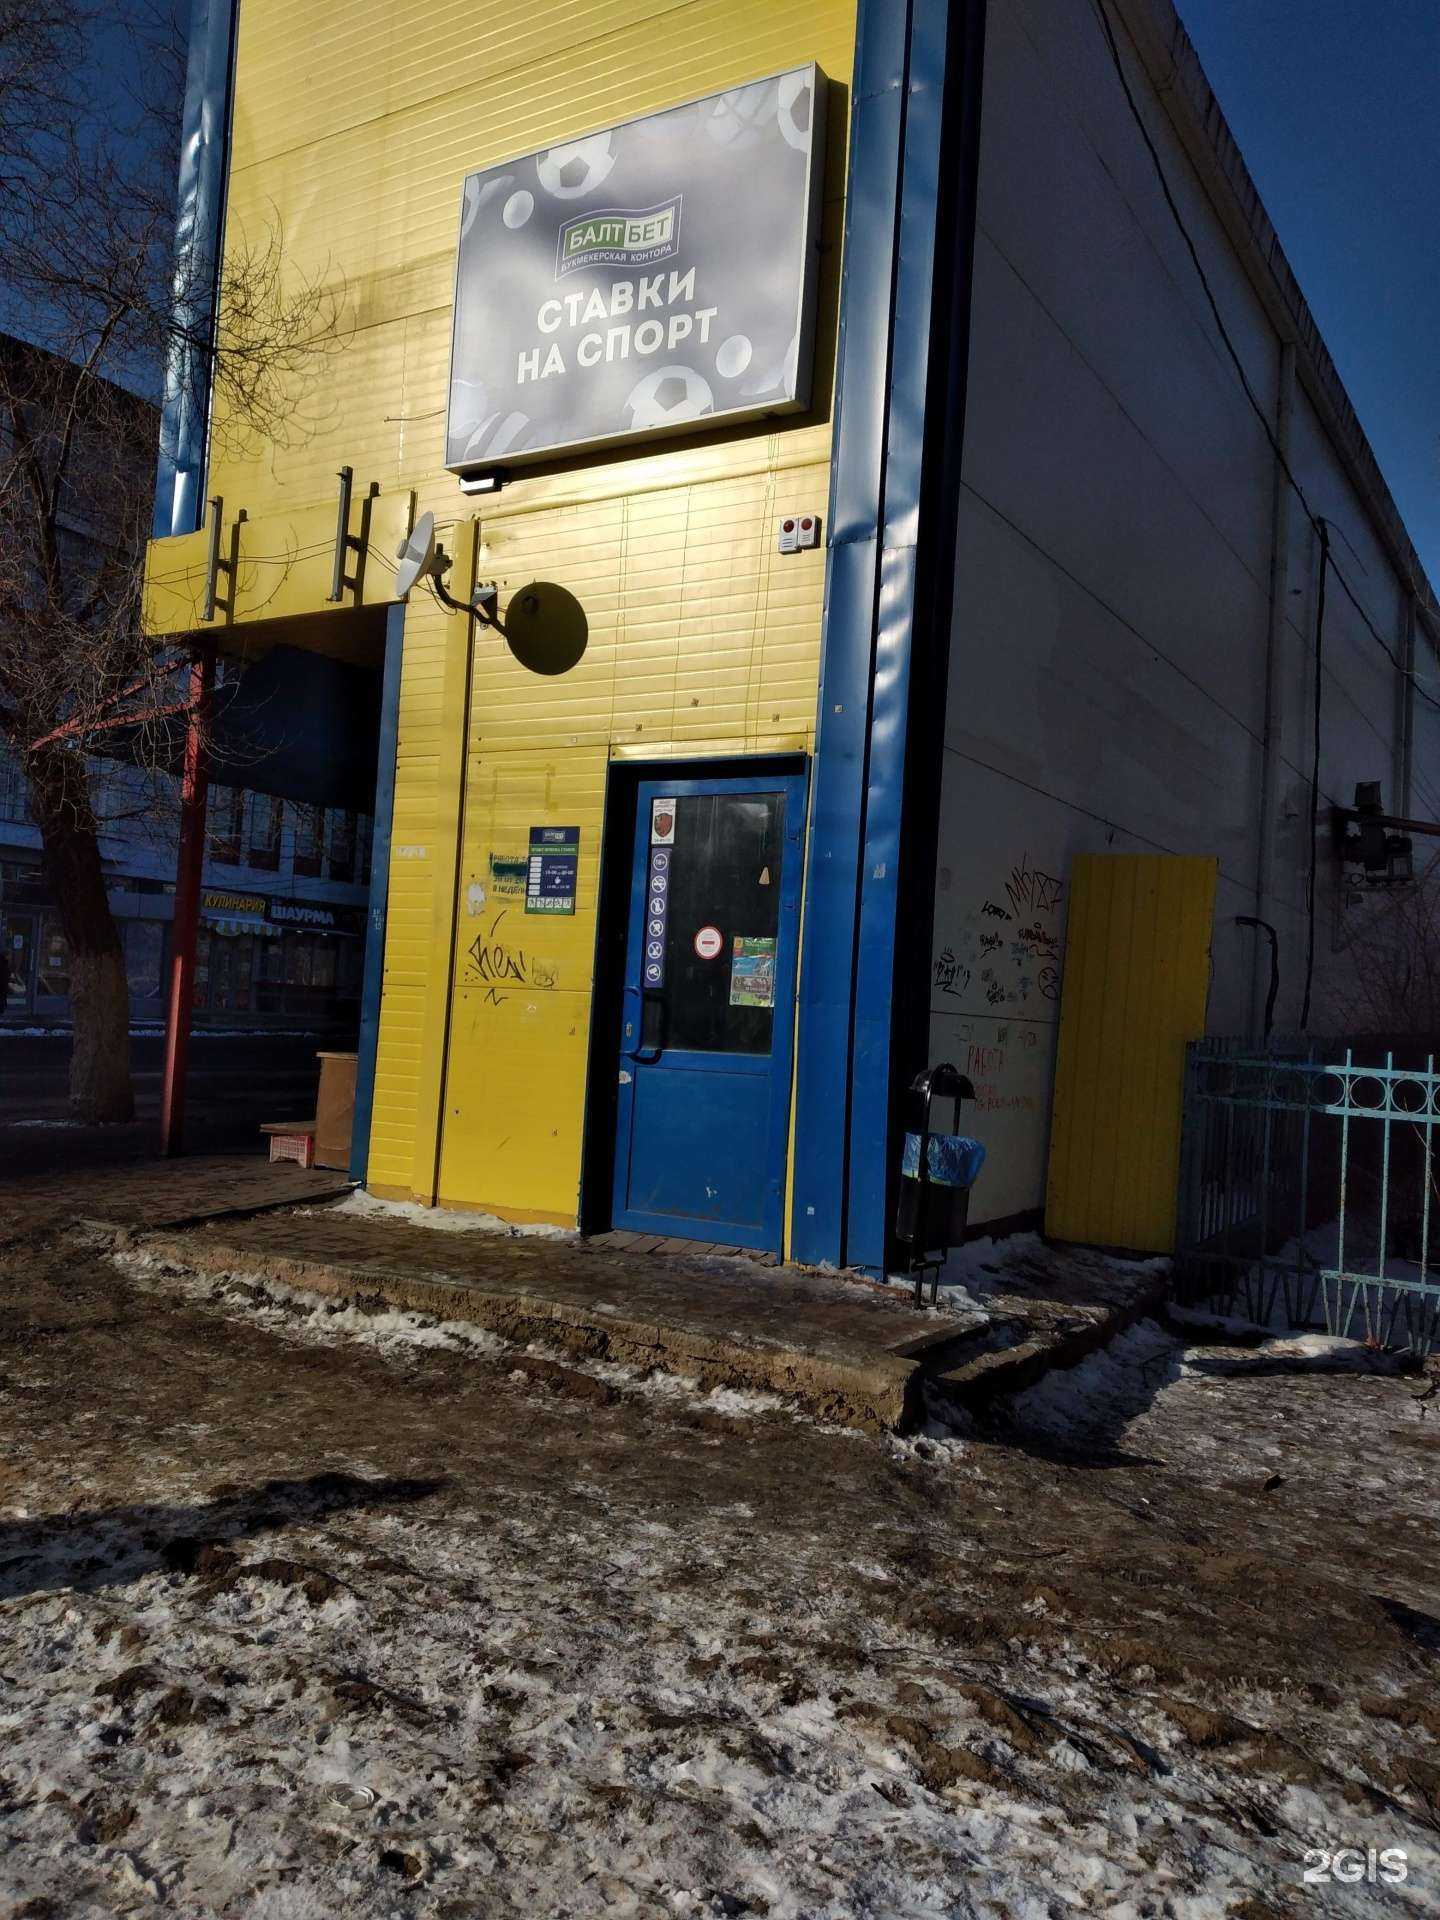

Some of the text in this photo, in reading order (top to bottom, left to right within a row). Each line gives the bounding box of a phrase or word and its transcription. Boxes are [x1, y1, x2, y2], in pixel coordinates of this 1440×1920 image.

[569, 216, 669, 250] БАЛТБЕТ
[561, 244, 672, 272] БУКМЕКЕРСКАЯ КОНТОРА
[537, 266, 696, 333] СТАВКИ
[516, 307, 718, 384] НА СПОРТ
[204, 894, 266, 913] КУЛИНАРИЯ
[270, 905, 335, 925] ШАУРМА
